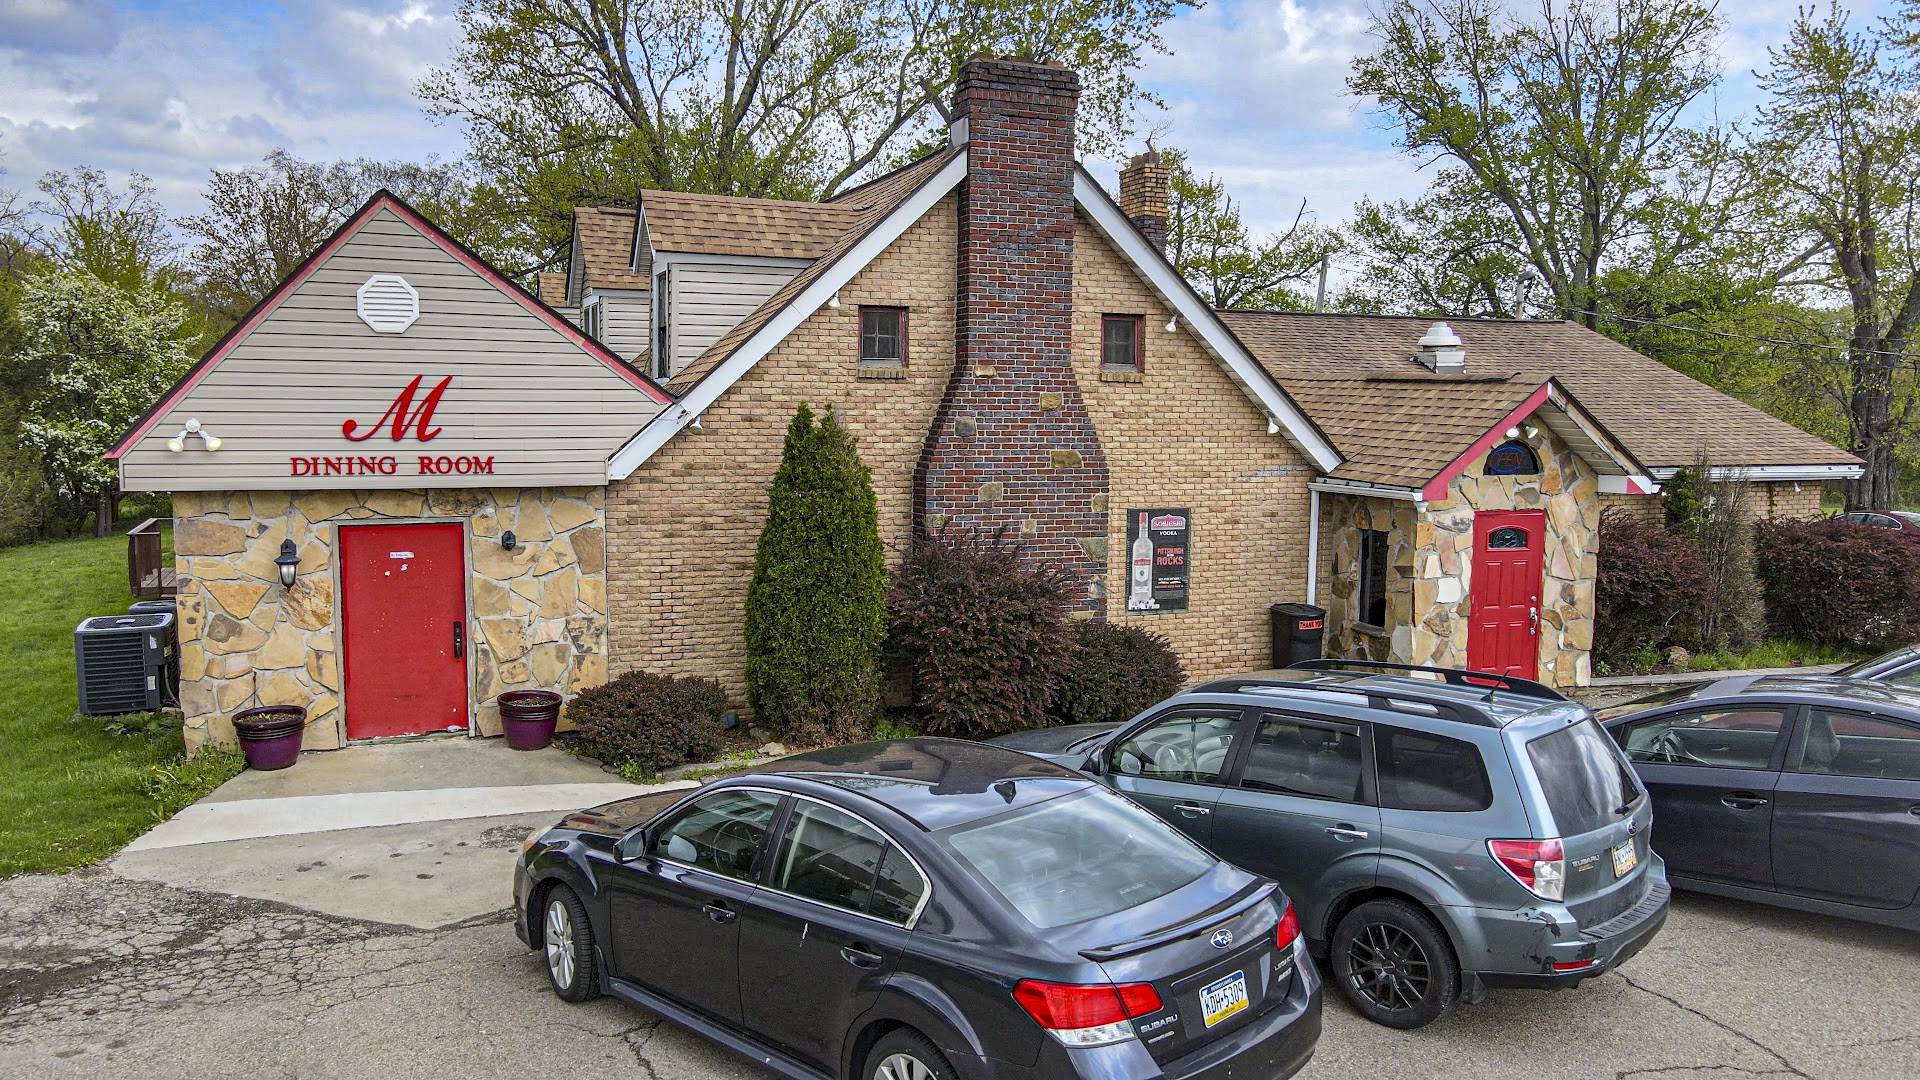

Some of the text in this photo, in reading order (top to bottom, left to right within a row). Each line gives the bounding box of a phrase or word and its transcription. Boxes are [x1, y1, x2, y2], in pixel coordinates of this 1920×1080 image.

[342, 374, 453, 442] M
[290, 456, 495, 476] DINING ROOM
[1156, 556, 1184, 566] ROCKS
[1572, 855, 1600, 867] SUBARU
[1140, 1013, 1178, 1033] SUBARU
